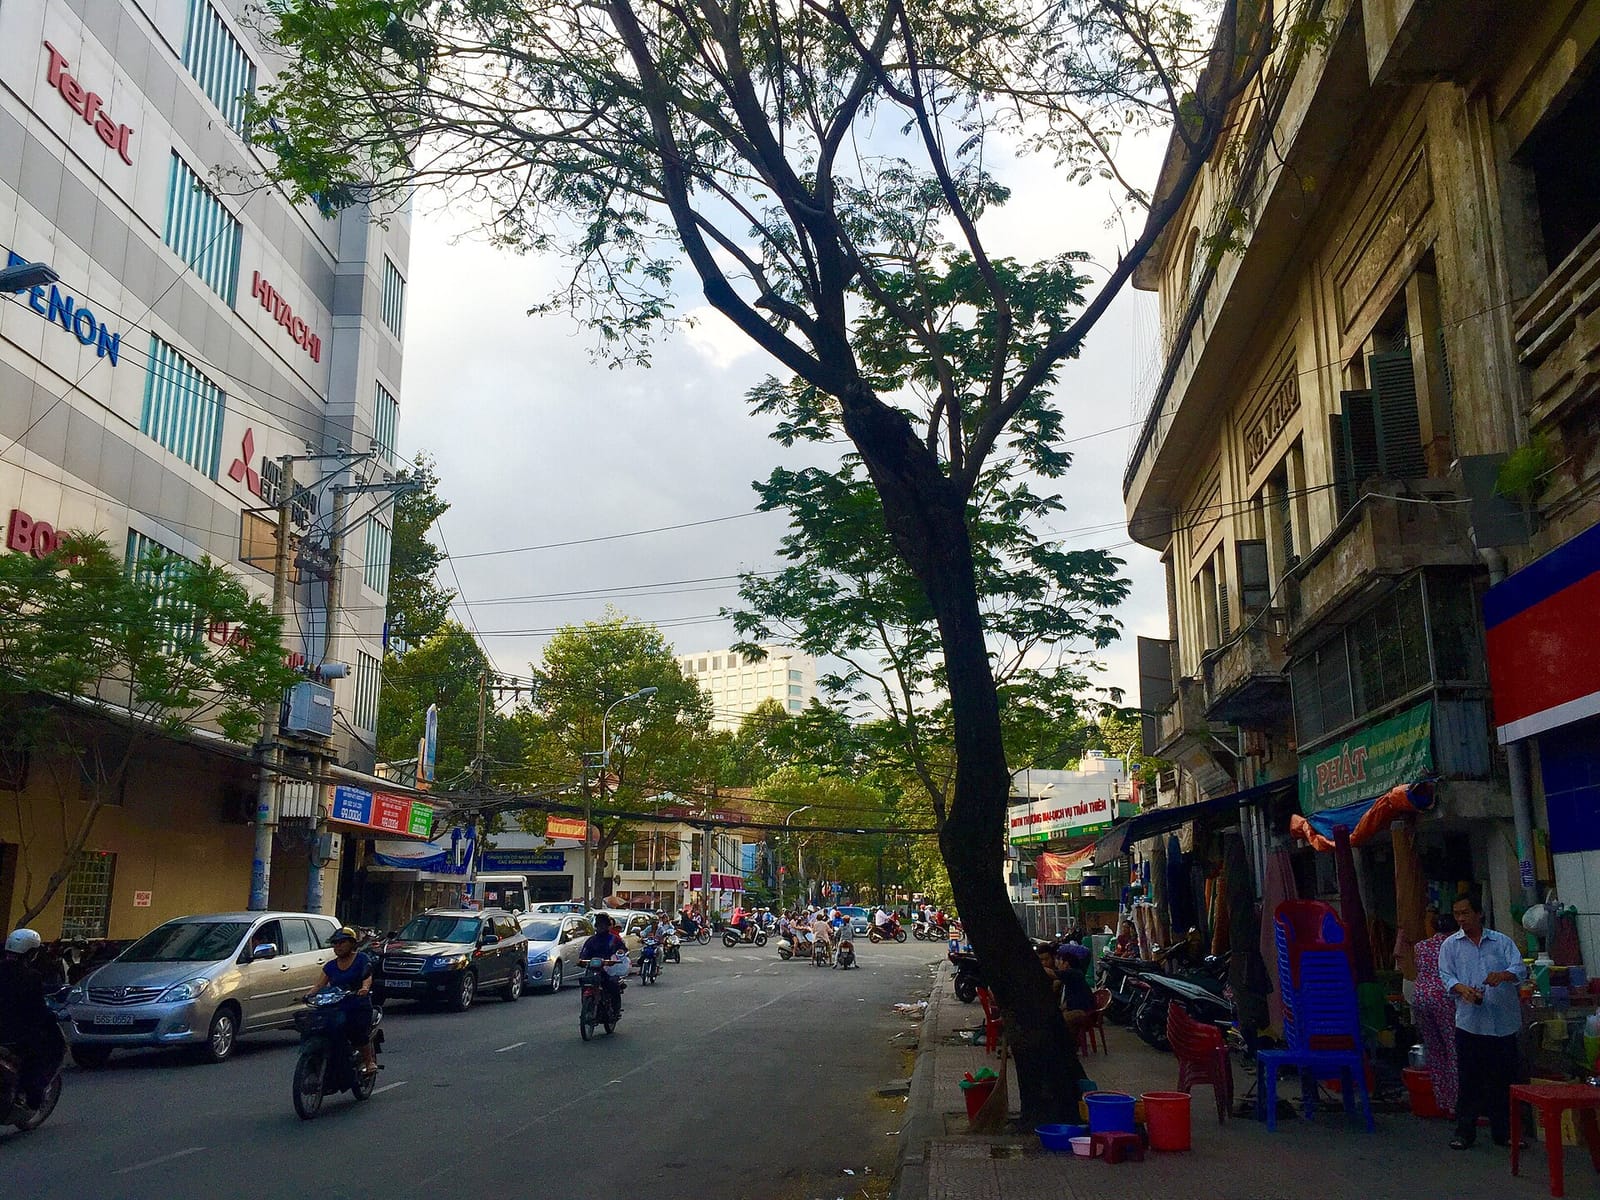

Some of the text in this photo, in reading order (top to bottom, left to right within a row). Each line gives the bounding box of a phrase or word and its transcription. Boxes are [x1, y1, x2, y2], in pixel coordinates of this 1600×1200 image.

[43, 40, 133, 166] Tefal
[252, 270, 321, 363] HITACHI
[1316, 742, 1368, 797] PHÁT
